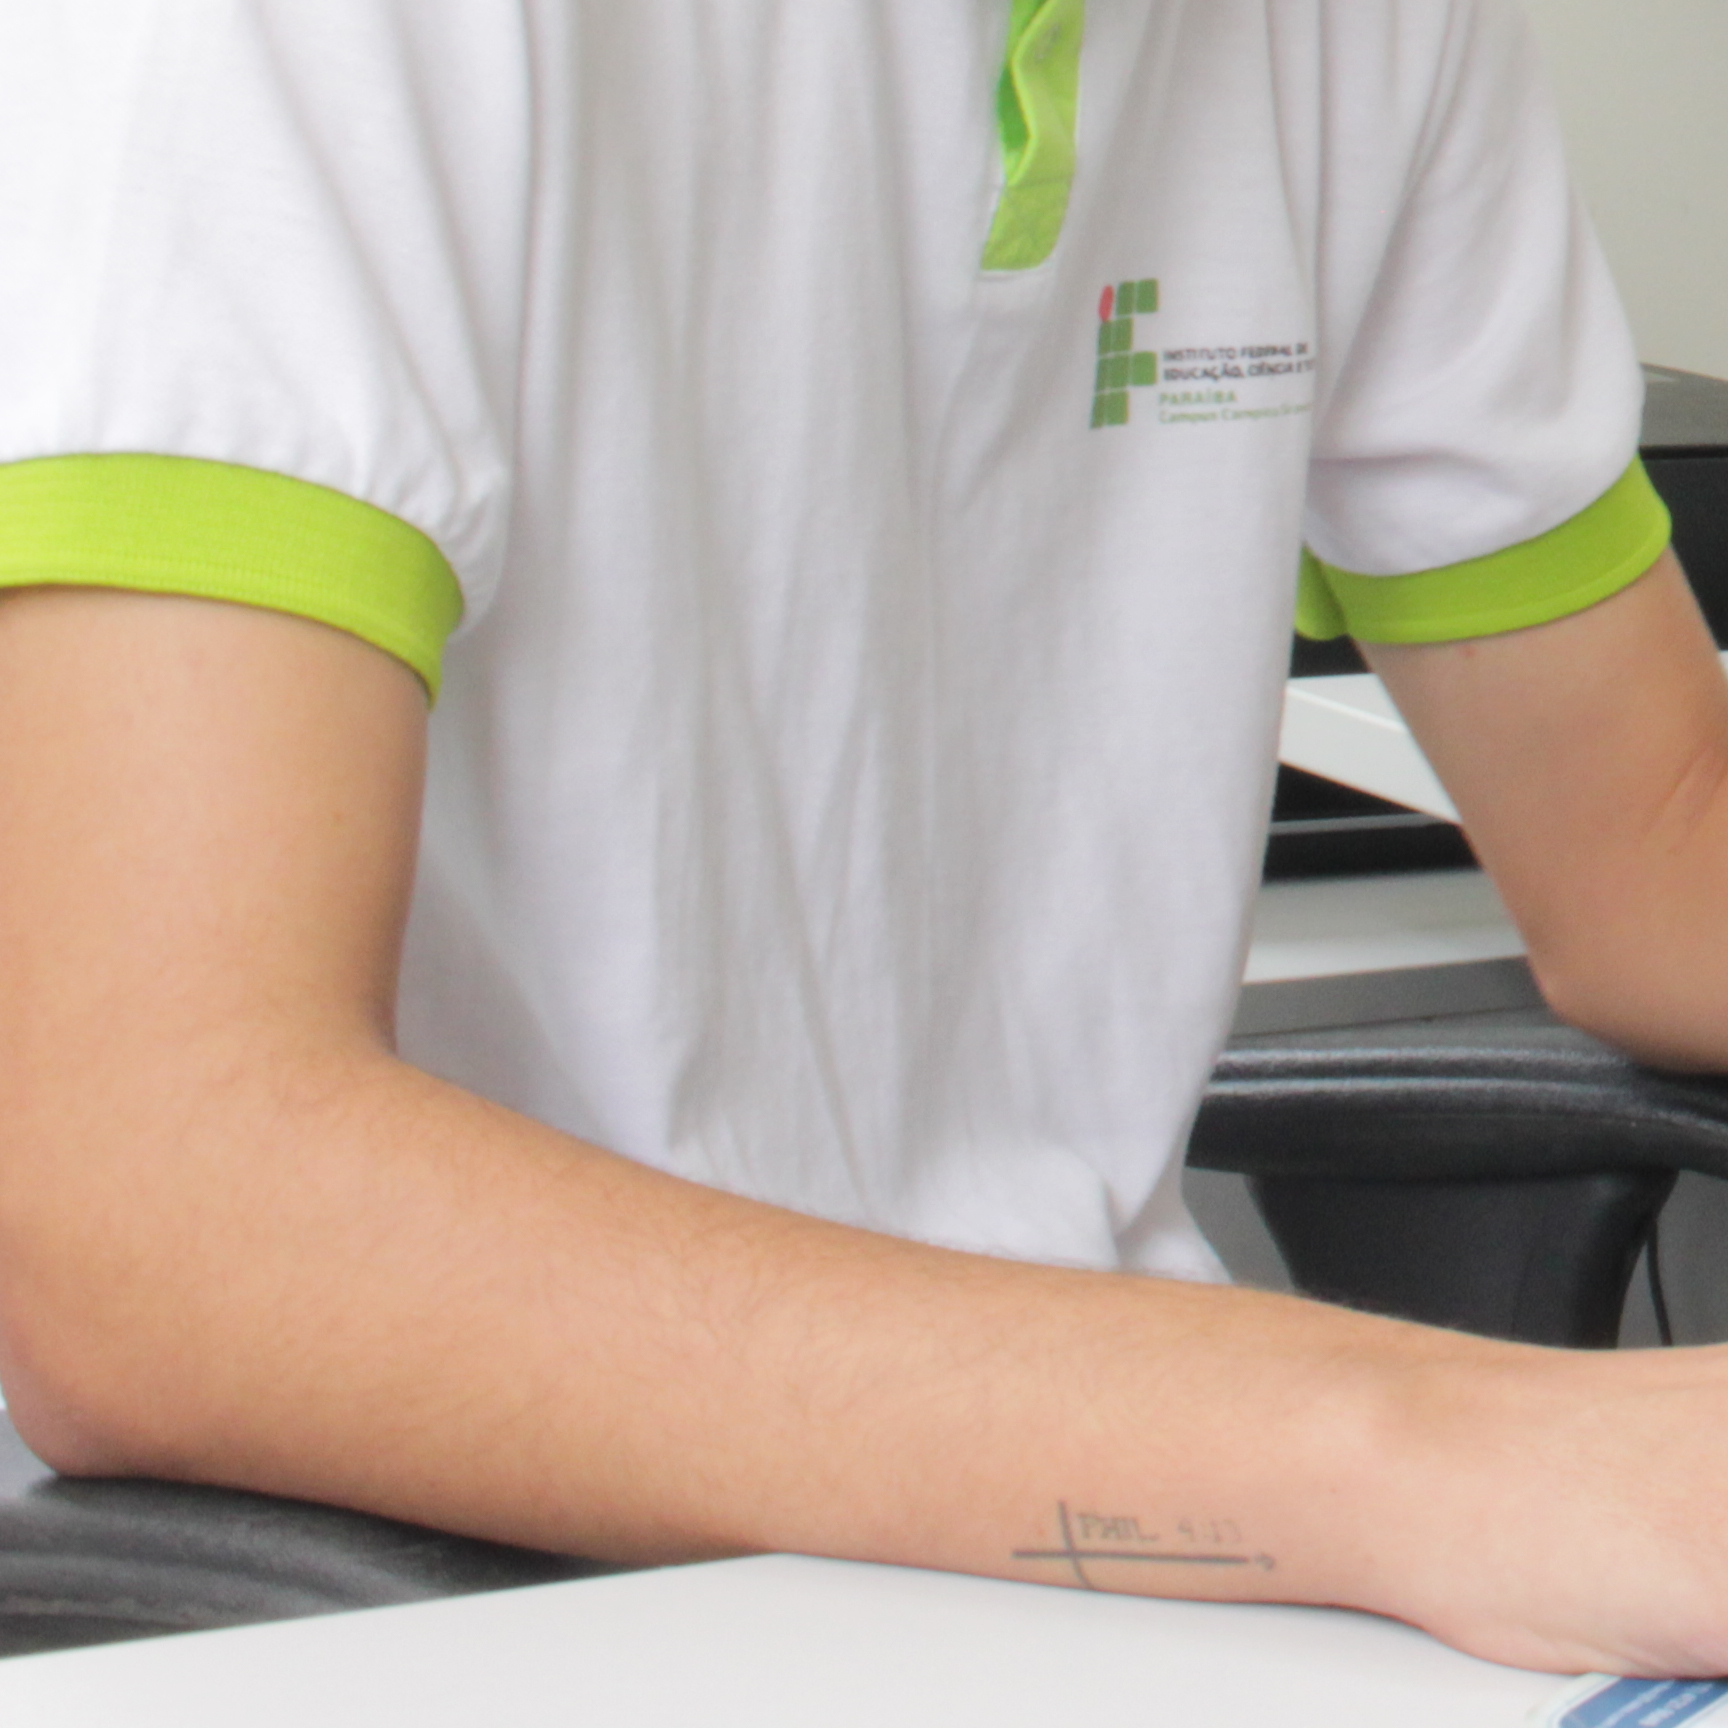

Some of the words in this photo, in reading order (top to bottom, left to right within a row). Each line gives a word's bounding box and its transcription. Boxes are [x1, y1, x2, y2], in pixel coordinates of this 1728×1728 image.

[1164, 347, 1237, 361] INSTITUTO
[1240, 345, 1293, 359] FEDERAL
[1160, 389, 1236, 404] PARAÍBA
